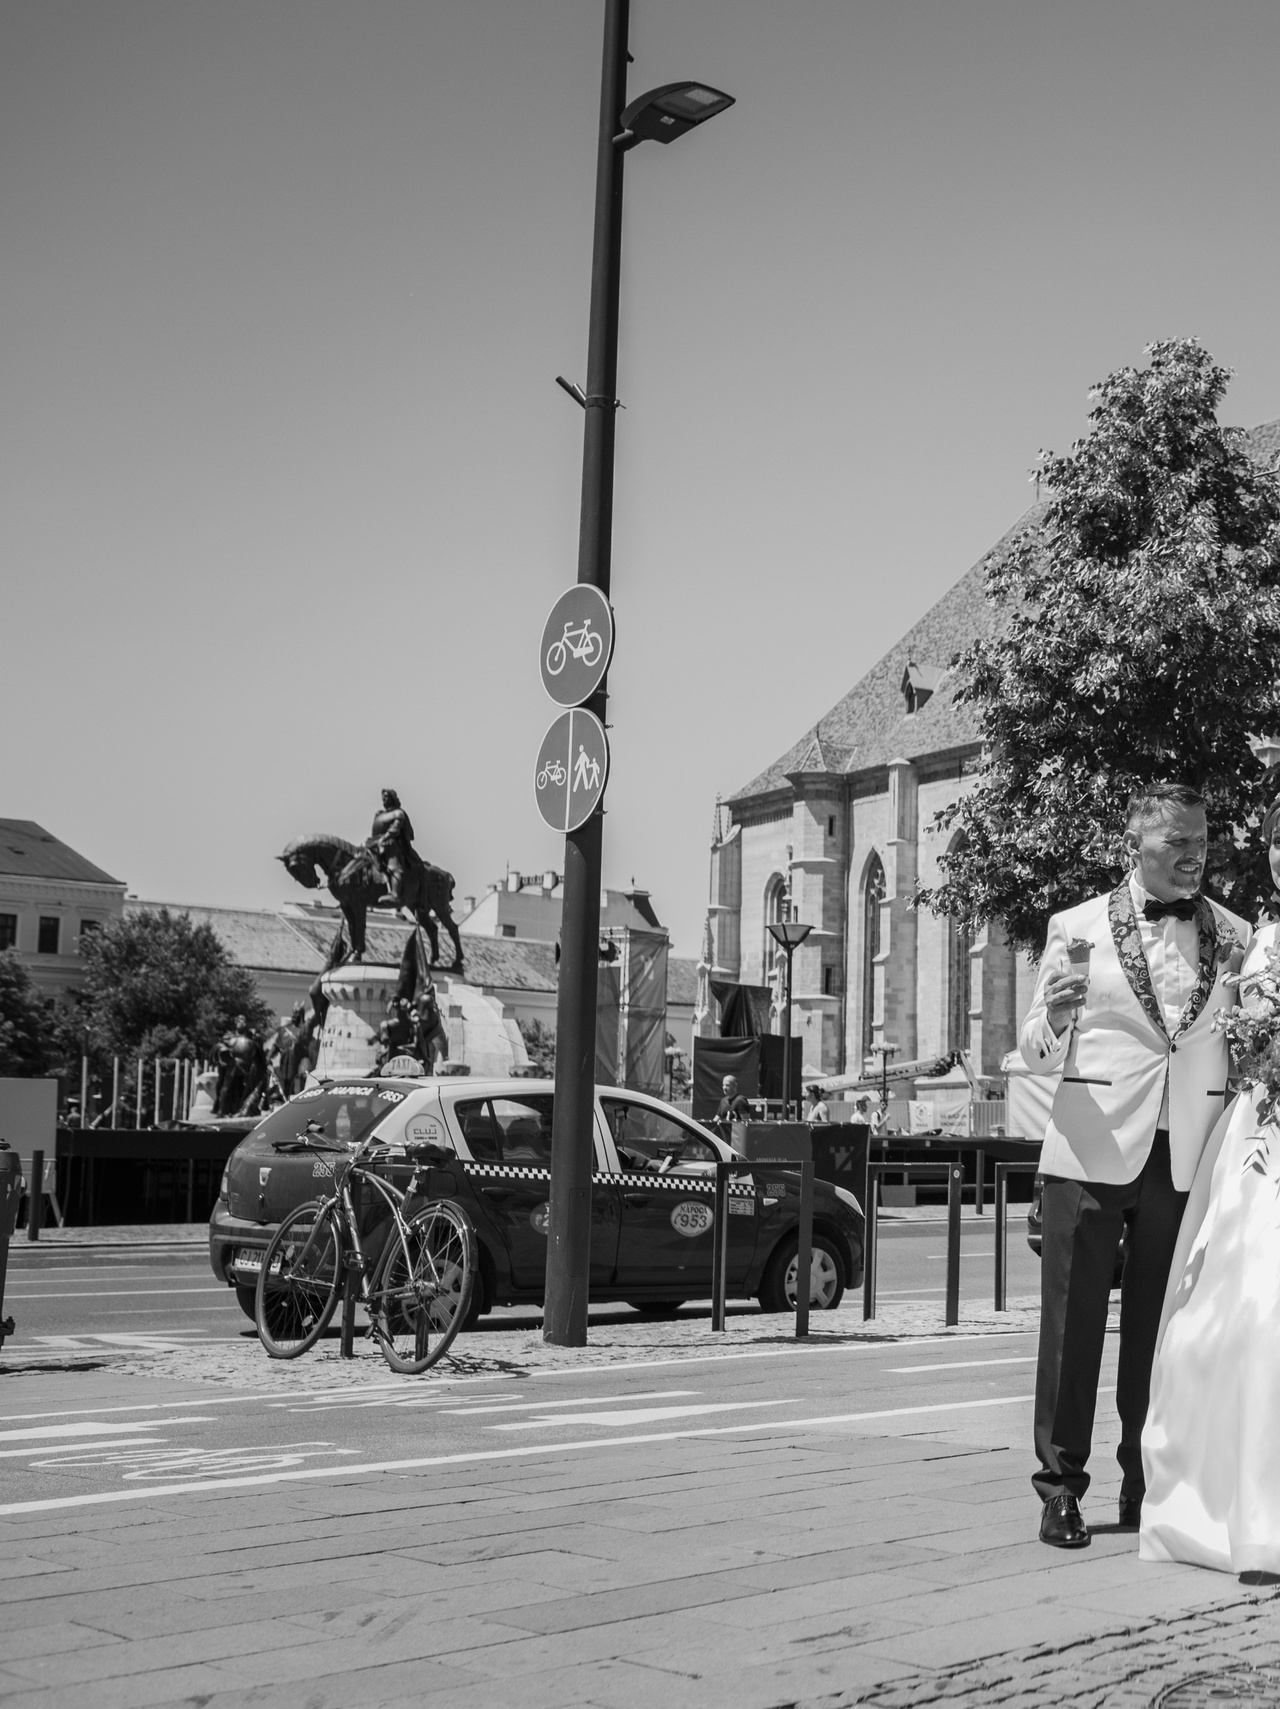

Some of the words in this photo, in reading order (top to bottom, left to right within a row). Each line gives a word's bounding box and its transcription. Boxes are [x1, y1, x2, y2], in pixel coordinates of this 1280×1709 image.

[391, 1058, 411, 1071] TAXI
[327, 1086, 374, 1096] NAPOCA
[766, 1183, 786, 1198] 255
[680, 1205, 708, 1215] NAPOCA
